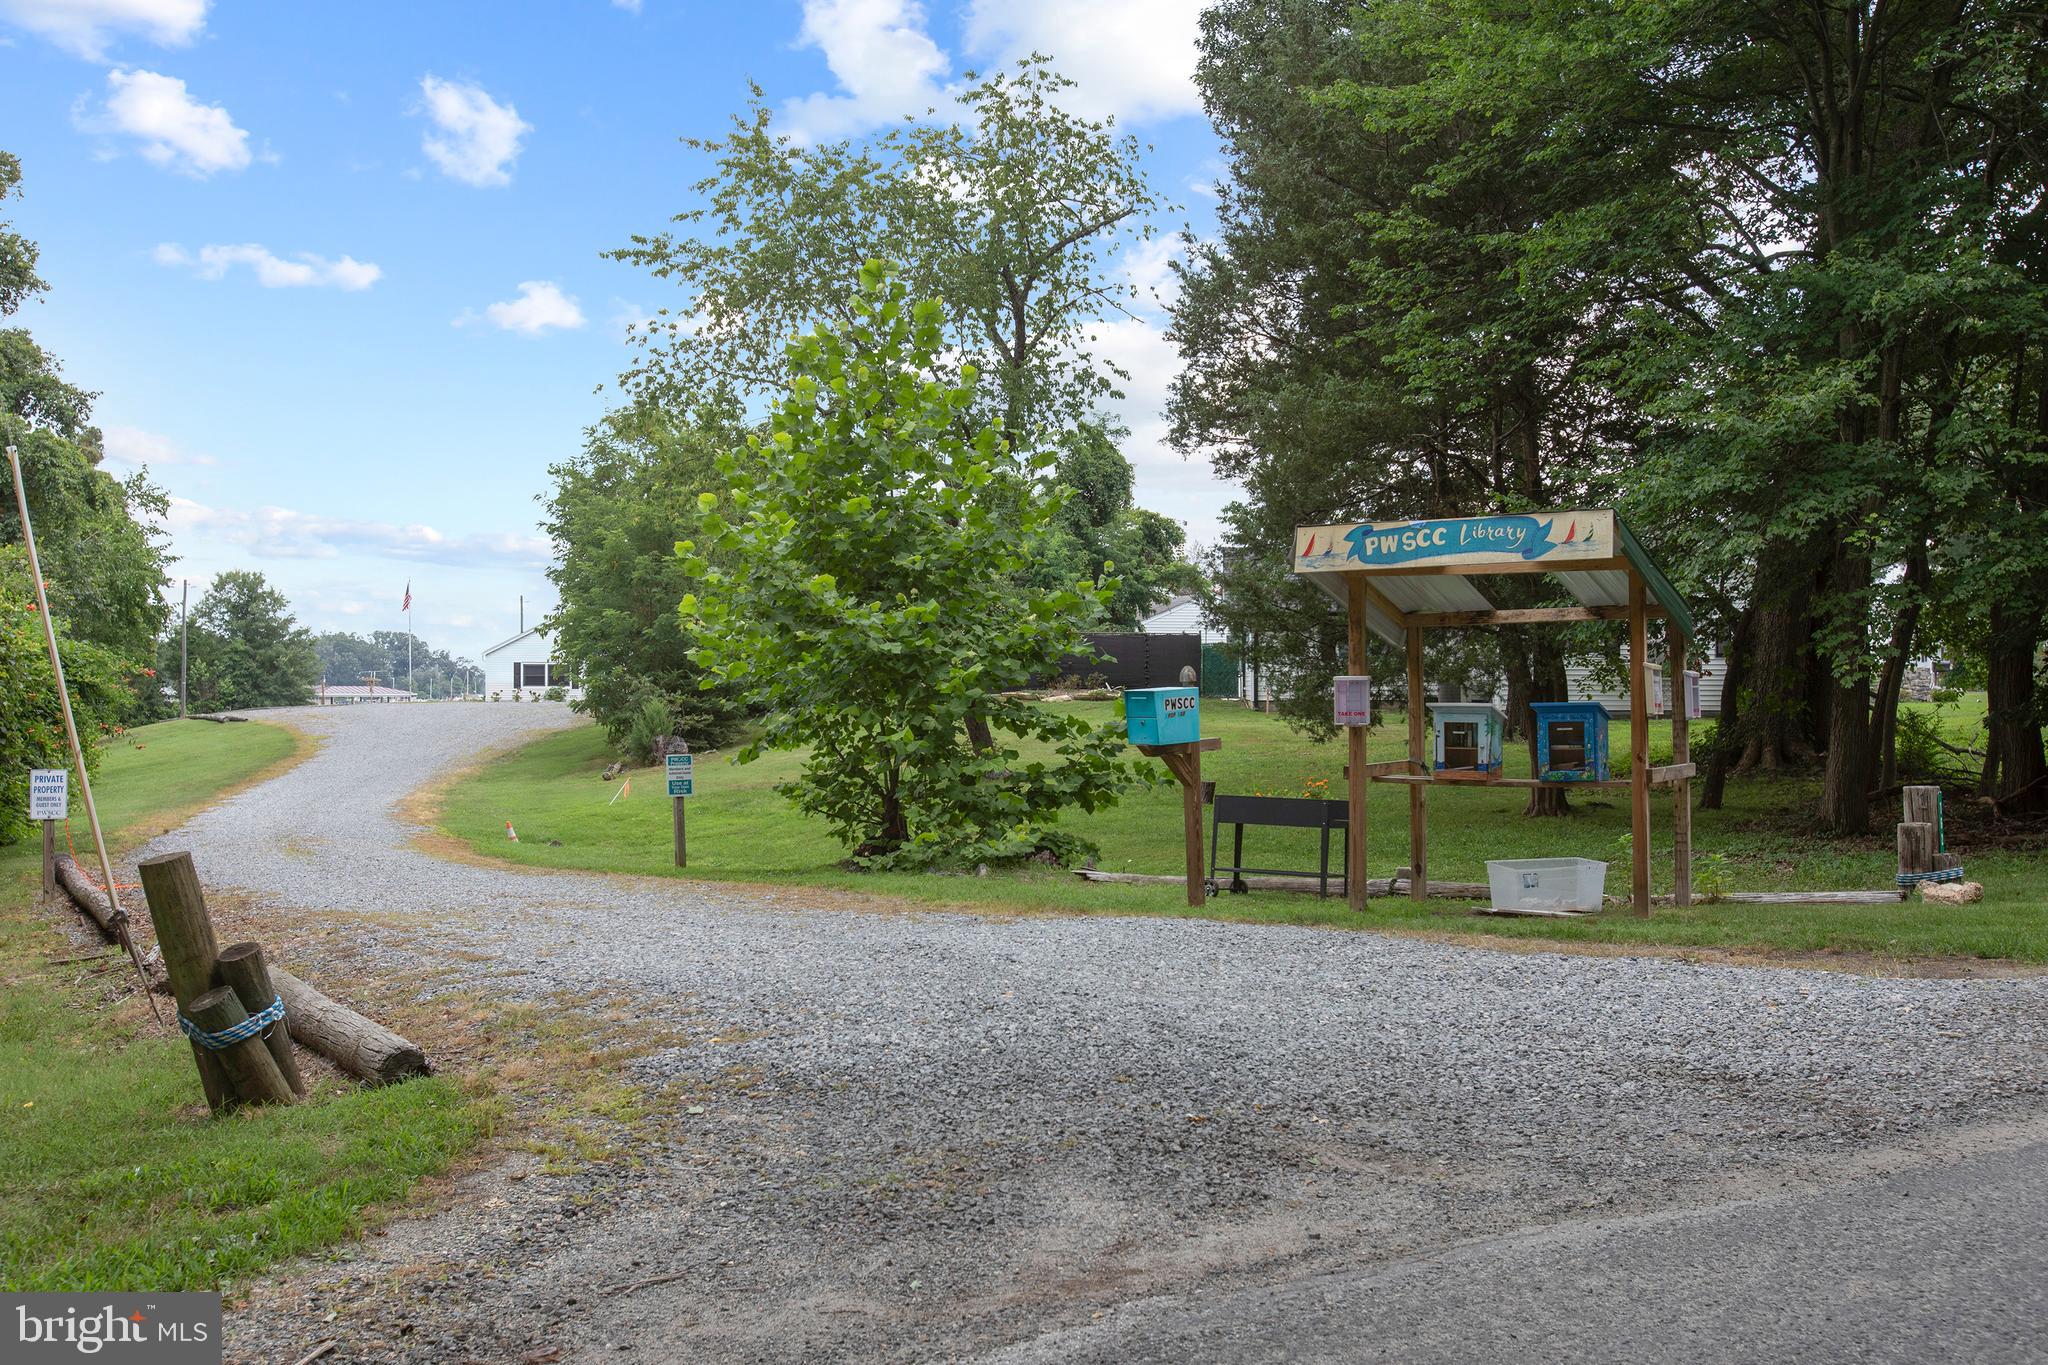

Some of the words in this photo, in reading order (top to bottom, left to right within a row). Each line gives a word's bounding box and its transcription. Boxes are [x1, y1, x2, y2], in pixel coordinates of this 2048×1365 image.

[1365, 527, 1446, 556] PWSCC
[1459, 523, 1527, 549] Library
[1165, 697, 1194, 710] PWSCC
